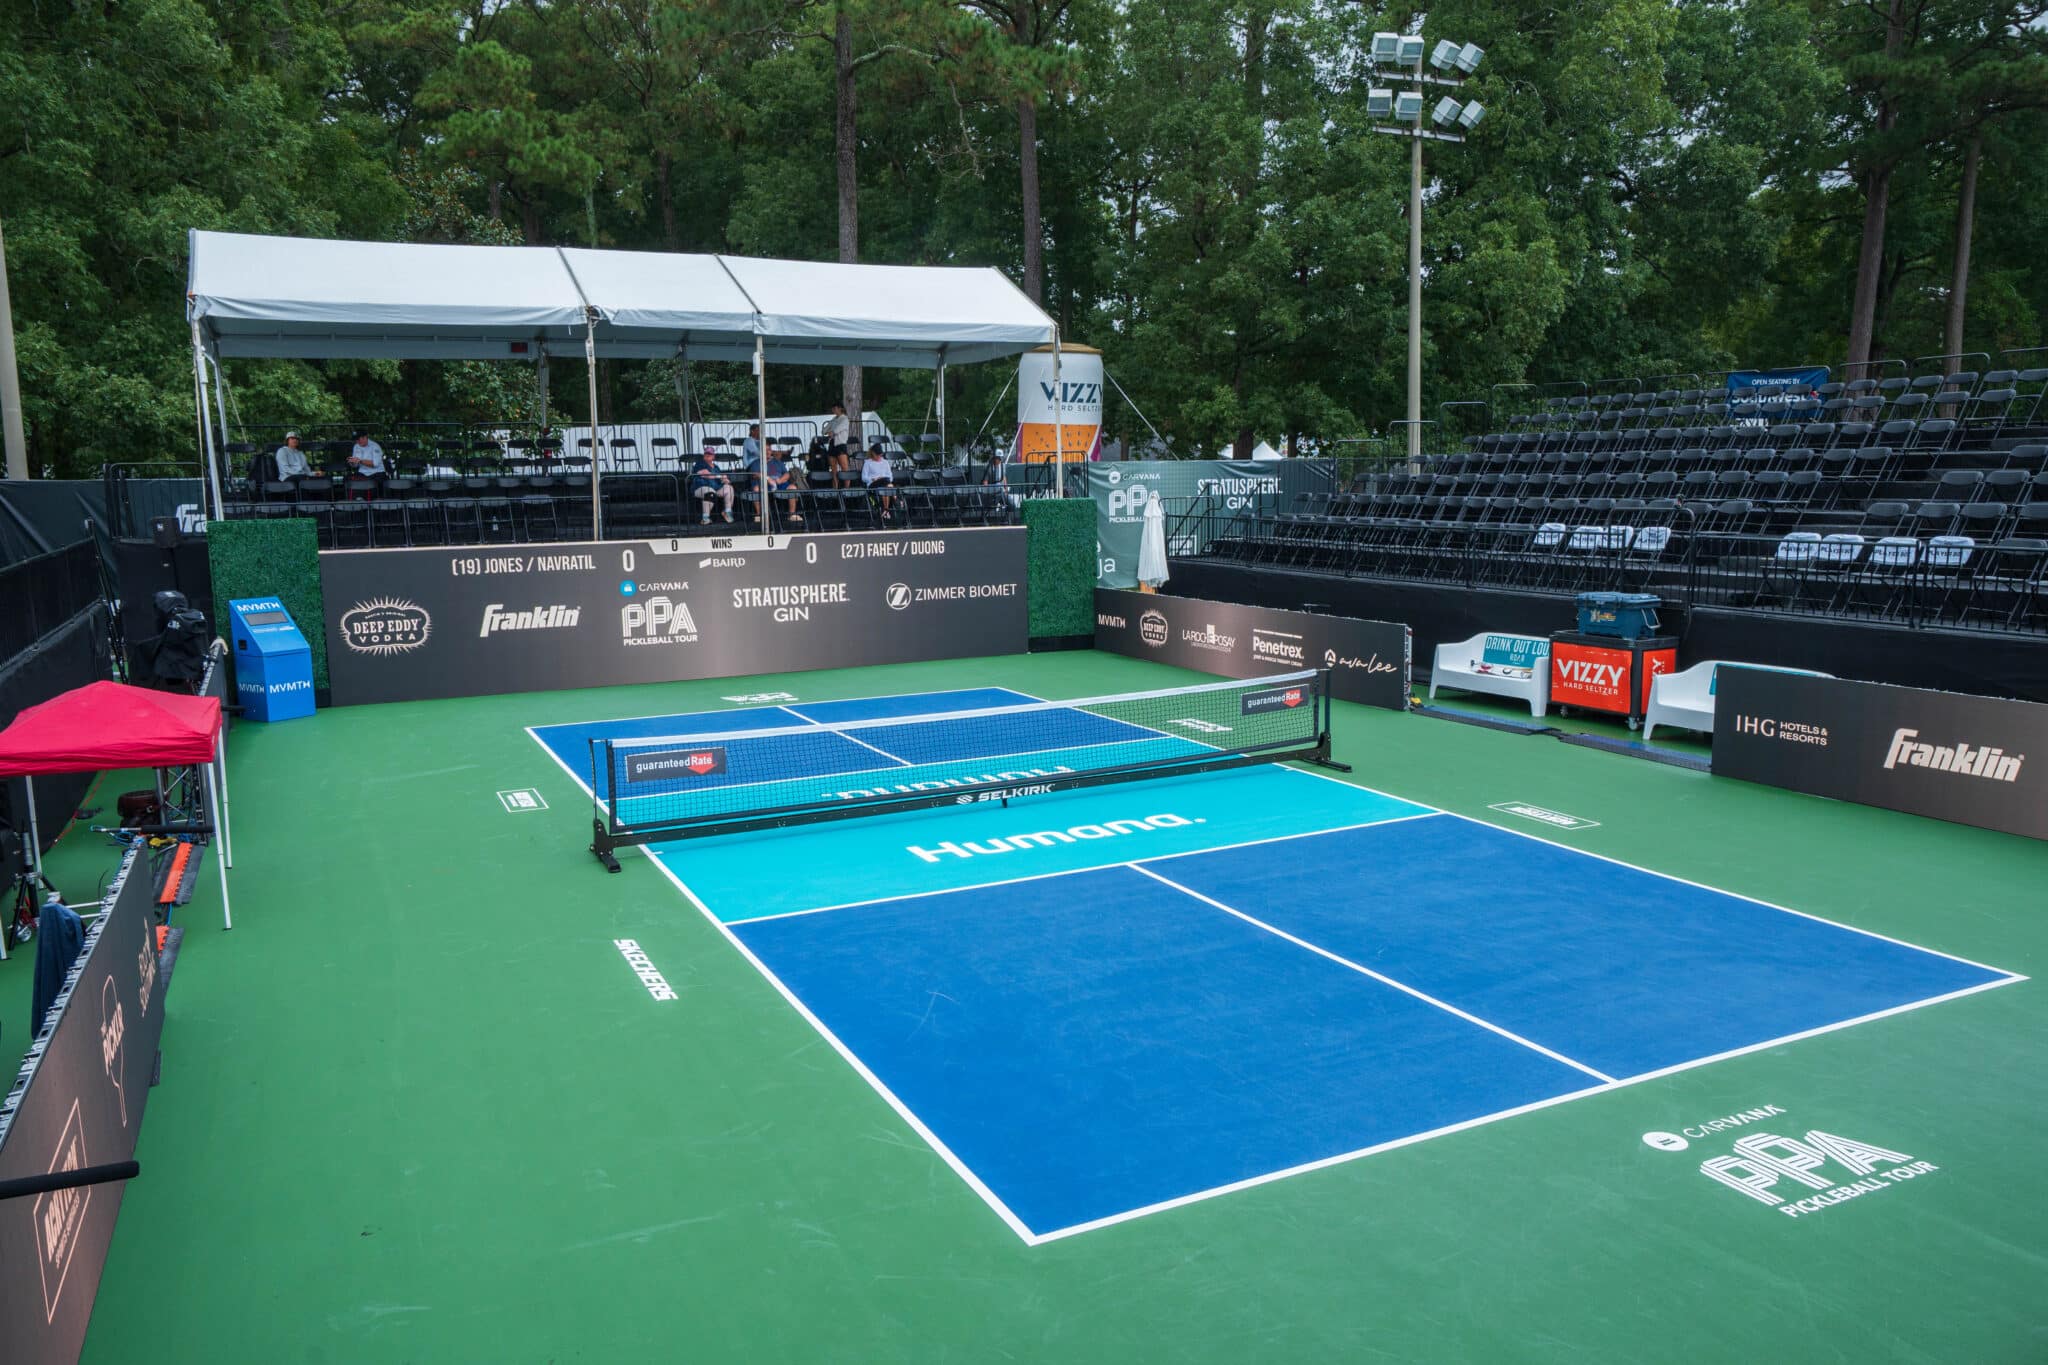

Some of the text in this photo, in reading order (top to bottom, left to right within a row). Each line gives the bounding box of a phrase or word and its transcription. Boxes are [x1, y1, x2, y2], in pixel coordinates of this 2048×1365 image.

[1048, 404, 1073, 412] HRD
[1108, 484, 1164, 516] PP
[1226, 496, 1253, 509] GIN
[672, 536, 774, 552] 0 WINS 0
[806, 542, 817, 563] 0
[868, 542, 899, 557] FAHEY
[912, 540, 945, 554] DUONG
[484, 557, 524, 574] JONES
[538, 554, 596, 572] NAVRATIL
[622, 549, 634, 572] 0
[712, 558, 746, 568] BAIRD
[639, 582, 688, 592] CARVANA
[733, 584, 847, 608] STRATUSPHERE
[915, 586, 966, 600] ZIMMER
[969, 584, 1017, 598] BIOMET
[622, 596, 698, 637] PPA
[774, 606, 809, 622] GIN
[352, 619, 418, 634] DEEP EDDY
[360, 633, 416, 643] VODKA
[624, 634, 698, 646] PICKLEBALL TOUR
[1486, 636, 1550, 656] DRINK OUT LOU
[1339, 653, 1398, 674] avalee
[1557, 658, 1624, 687] VIZZY
[1564, 682, 1618, 696] HARD SELTZER
[1736, 714, 1775, 737] IHG
[1780, 722, 1828, 736] HOTELS &
[1780, 731, 1828, 746] RESORTS
[978, 784, 1052, 802] SELKIRK
[906, 812, 1206, 862] Humana.
[613, 938, 679, 1001] SKECHERS
[1683, 1104, 1787, 1139] CARVANA
[1700, 1130, 1914, 1206] PPA
[1779, 1160, 1940, 1218] PICKLEBALL TOUR
